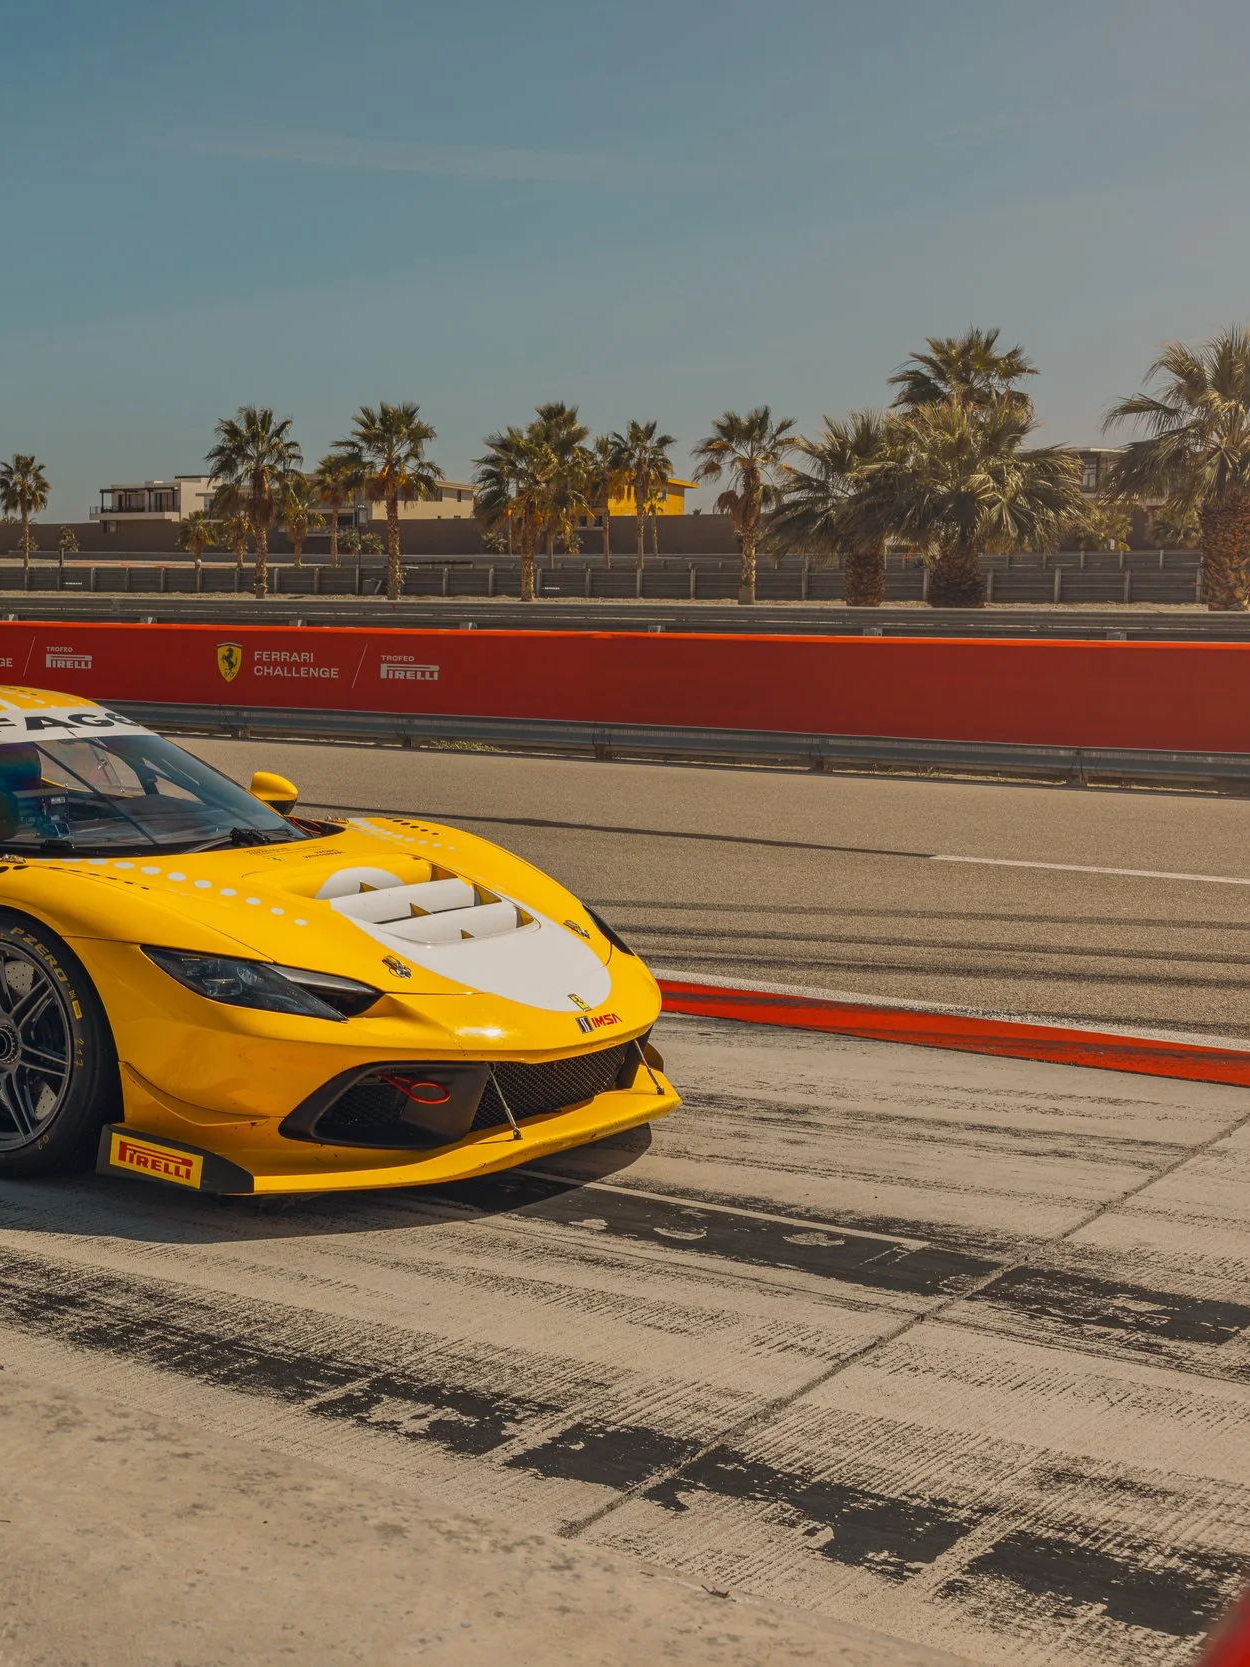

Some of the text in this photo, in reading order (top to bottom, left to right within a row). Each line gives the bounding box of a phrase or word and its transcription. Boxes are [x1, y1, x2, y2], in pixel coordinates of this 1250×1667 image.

[45, 653, 93, 669] PIRELLI
[254, 651, 314, 663] FERRARI
[381, 654, 415, 662] TROFEO
[254, 666, 339, 679] CHALLENGE
[380, 663, 440, 681] PIRELLI
[591, 1013, 623, 1028] IMSA
[117, 1140, 194, 1180] PIRELLI
